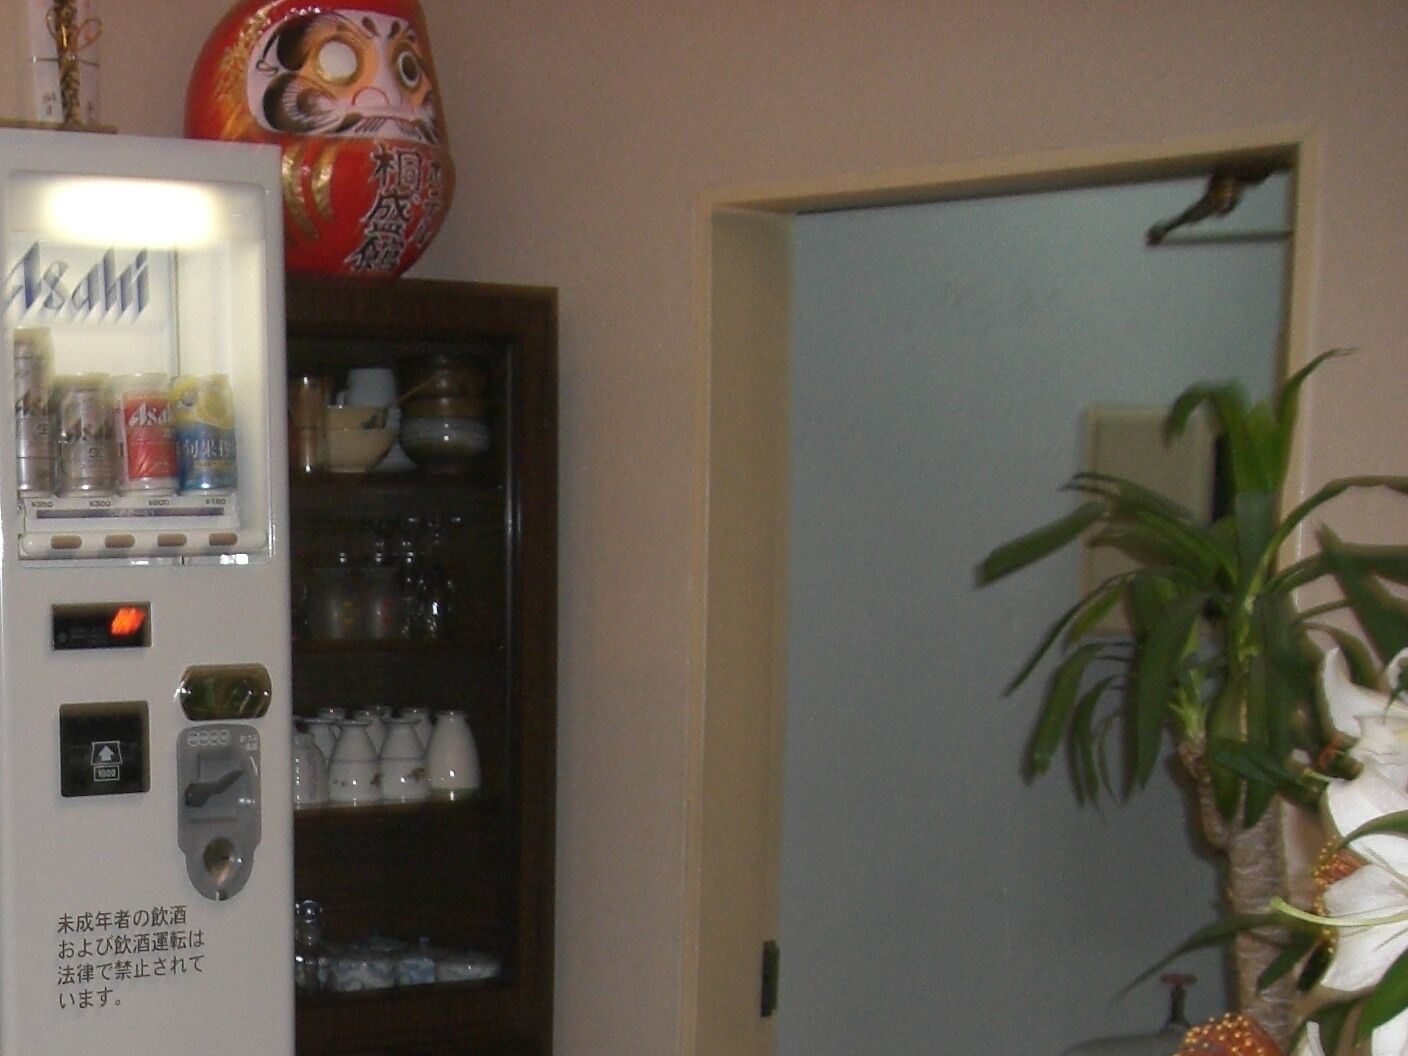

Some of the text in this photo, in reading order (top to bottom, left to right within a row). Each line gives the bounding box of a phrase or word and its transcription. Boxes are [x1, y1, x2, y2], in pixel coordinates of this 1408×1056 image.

[5, 241, 151, 313] Asahi
[58, 905, 187, 933] 未成年者の飲酒
[59, 929, 205, 959] および飲酒運転は
[57, 955, 205, 986] 法律で禁止されて
[59, 986, 121, 1009] います。
